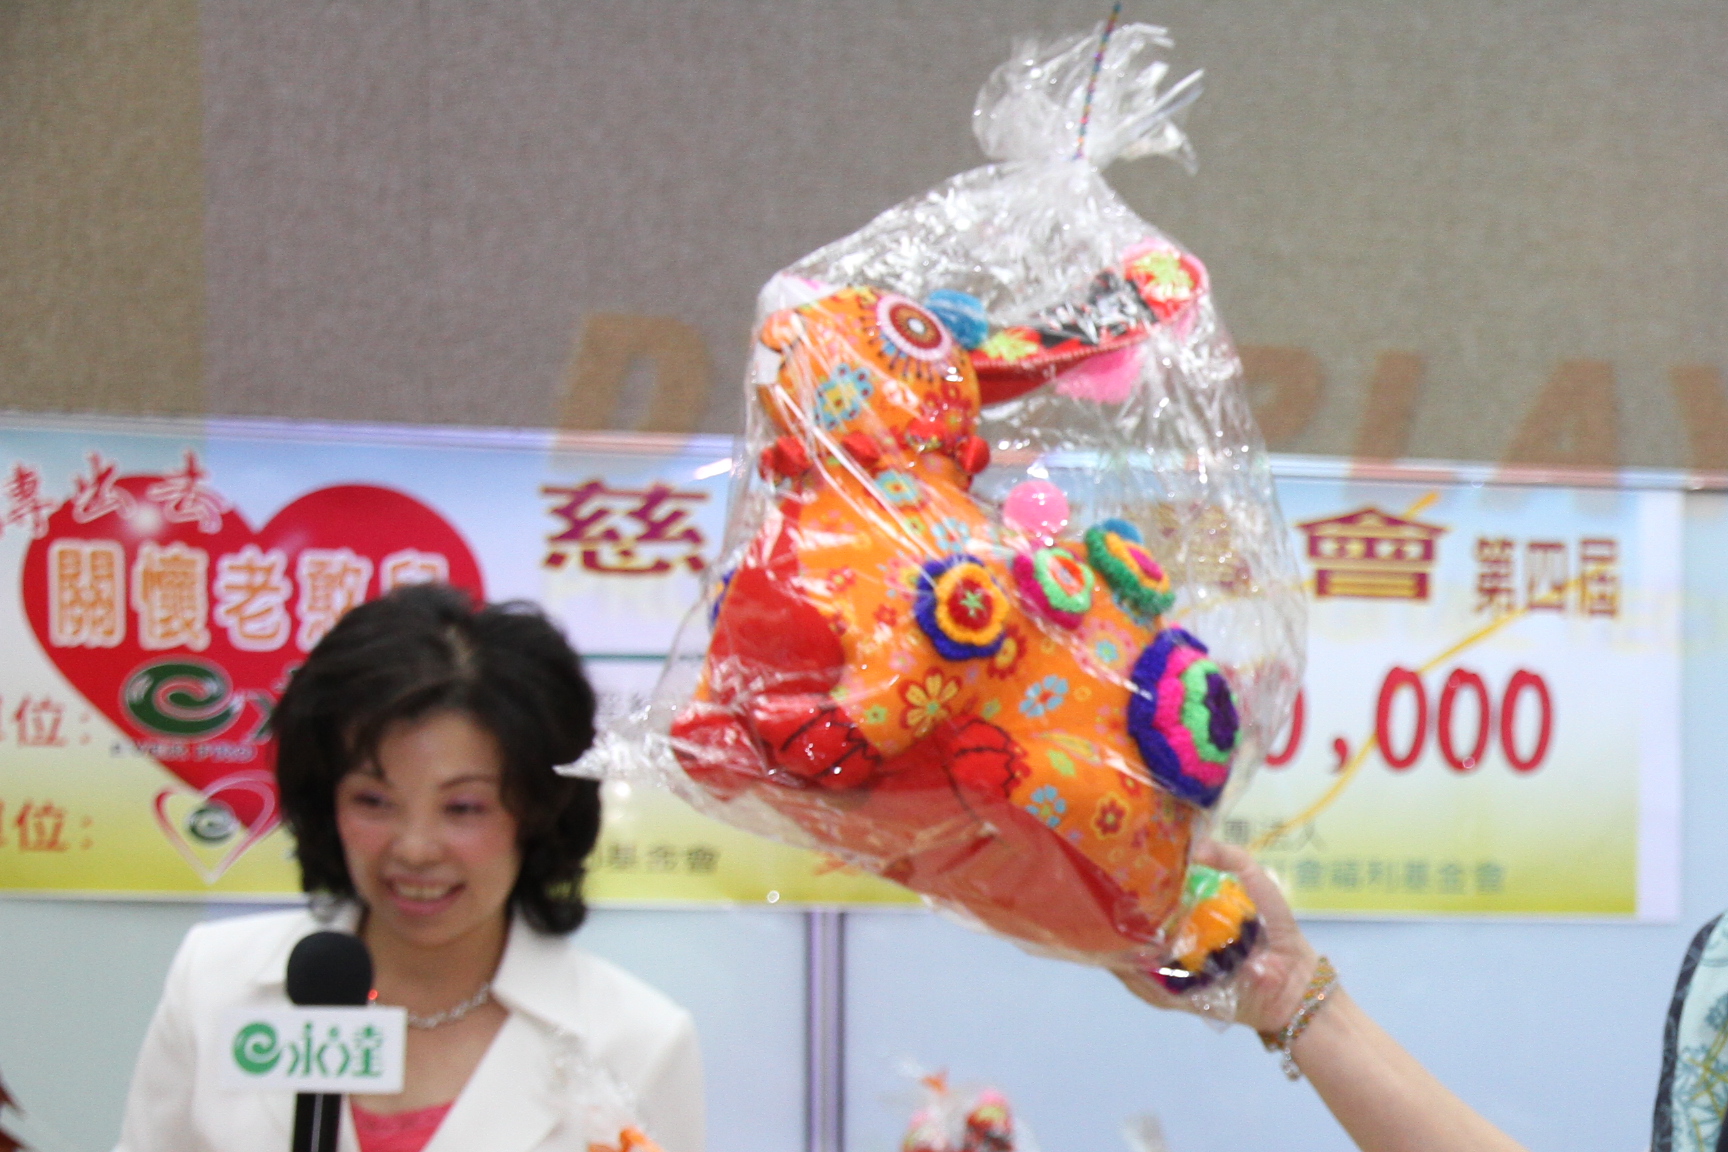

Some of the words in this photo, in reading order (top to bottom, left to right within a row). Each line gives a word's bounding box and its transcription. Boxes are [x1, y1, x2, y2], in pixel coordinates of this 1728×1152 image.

[540, 480, 708, 576] 慈
[1474, 536, 1620, 620] 第四屆
[0, 696, 92, 748] 位：
[0, 800, 94, 852] 位：
